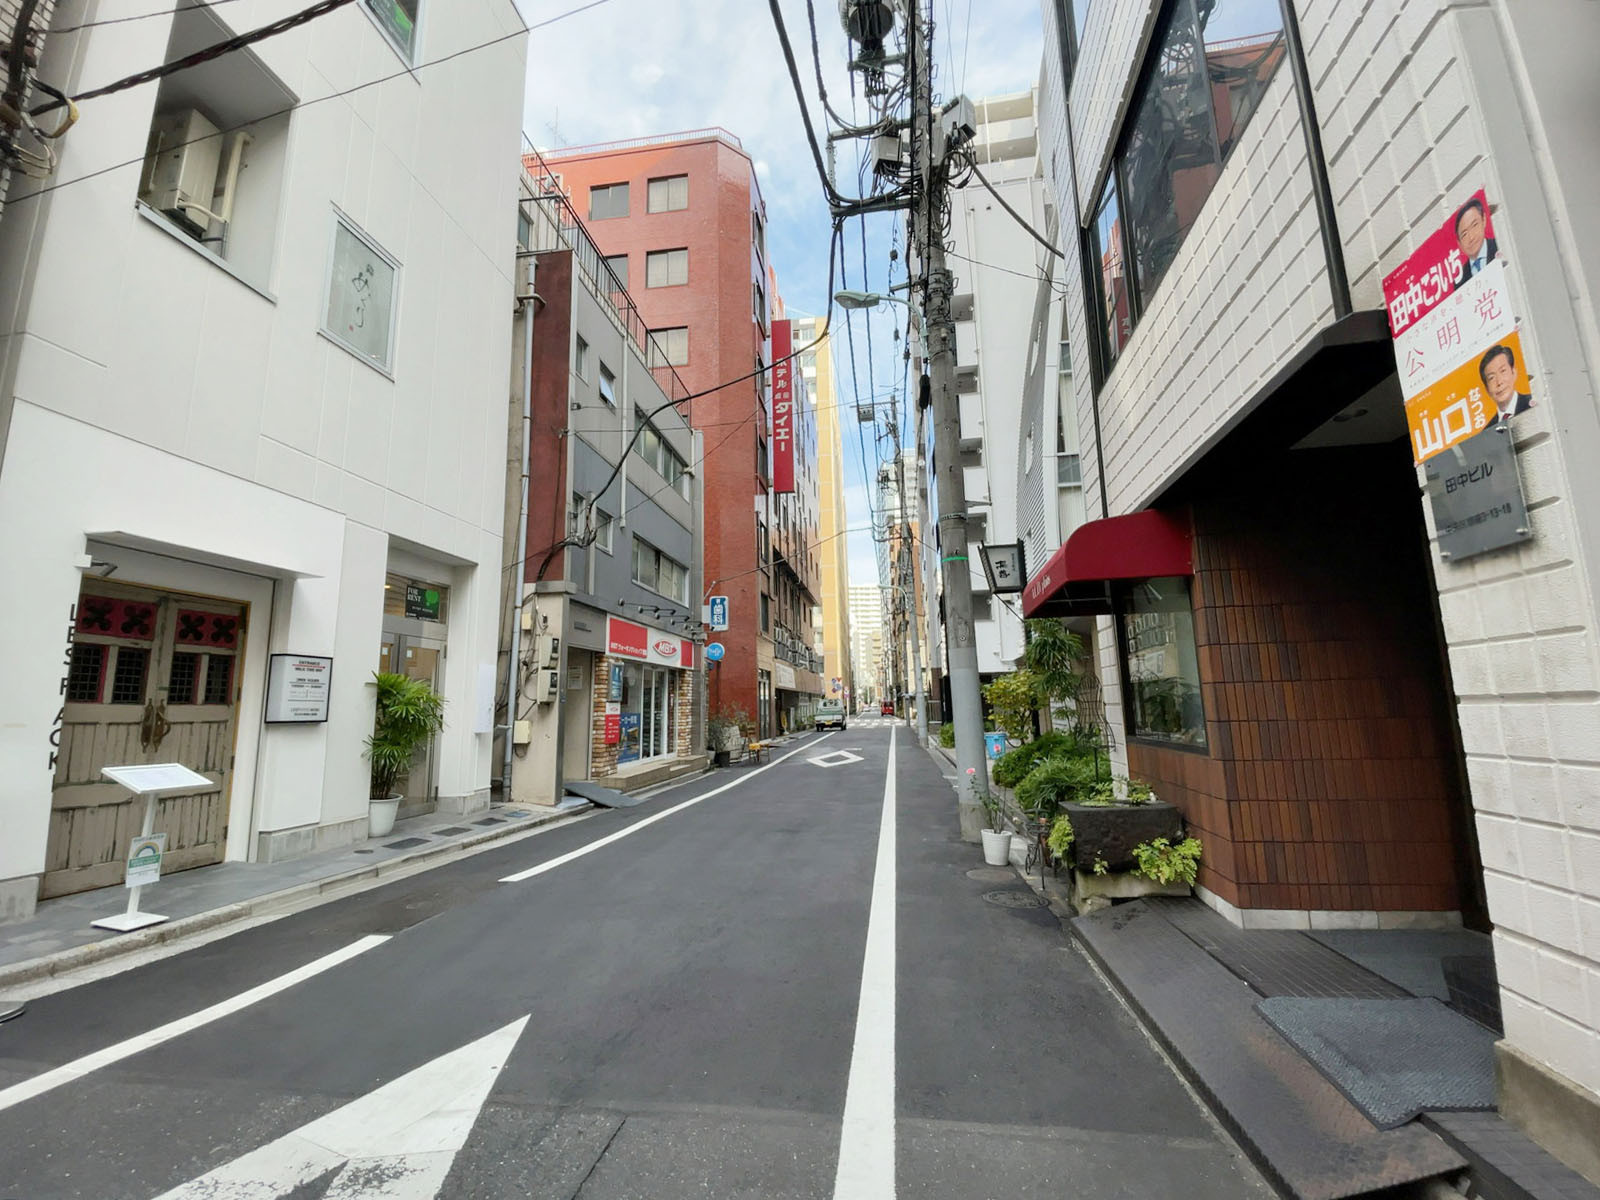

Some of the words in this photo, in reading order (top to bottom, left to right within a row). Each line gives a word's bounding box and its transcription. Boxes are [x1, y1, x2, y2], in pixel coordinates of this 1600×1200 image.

[1389, 248, 1464, 334] 田中こういち
[1405, 288, 1501, 378] 公明党
[1414, 397, 1472, 460] 山口
[1468, 386, 1486, 429] なつお
[1445, 461, 1493, 494] 田中ビル
